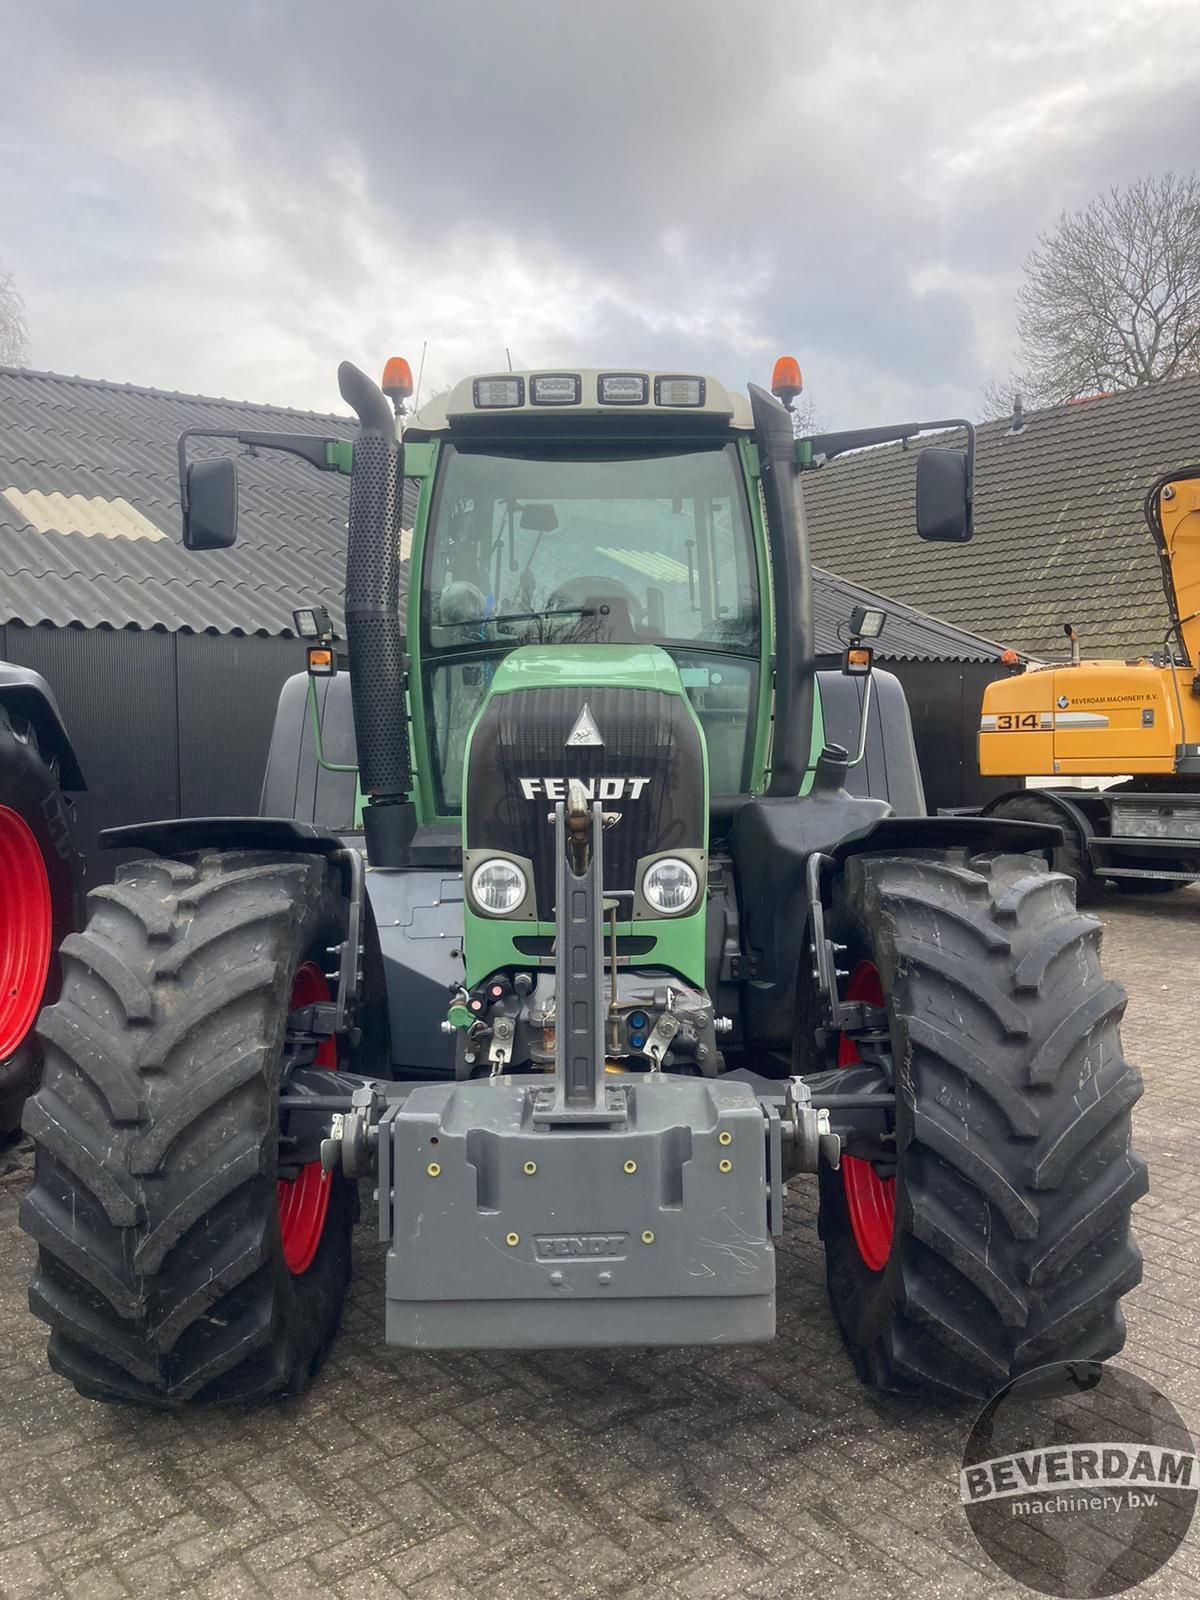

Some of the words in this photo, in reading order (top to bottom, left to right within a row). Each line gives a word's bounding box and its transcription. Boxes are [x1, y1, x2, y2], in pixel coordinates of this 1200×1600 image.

[1071, 696, 1106, 705] BEVERDAM
[1106, 694, 1145, 704] MACHINERY
[997, 714, 1039, 730] 314
[518, 776, 652, 800] FENDT
[536, 1236, 626, 1257] FENDT
